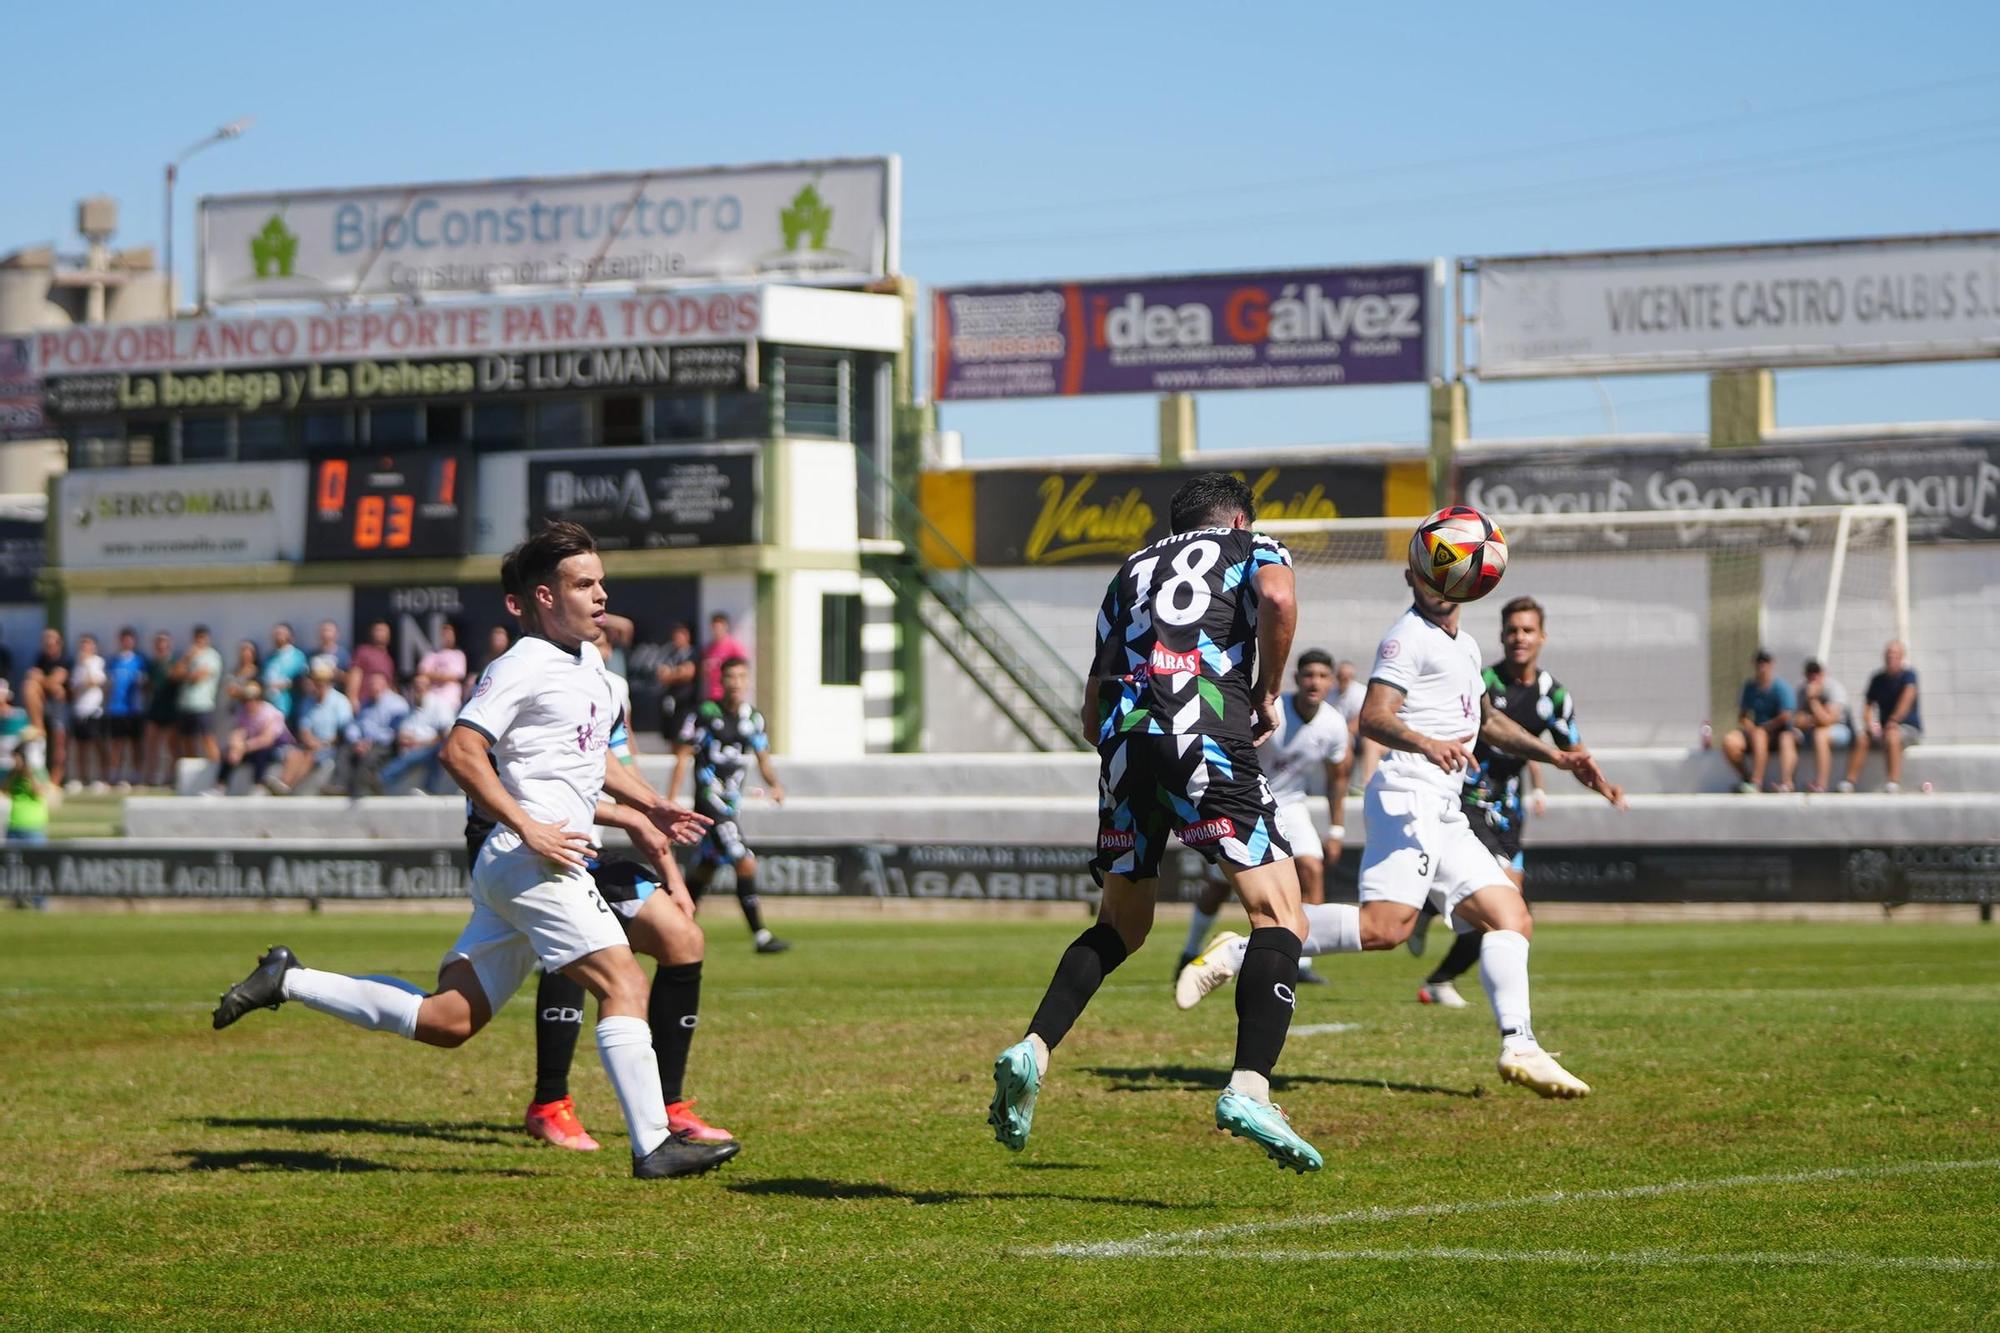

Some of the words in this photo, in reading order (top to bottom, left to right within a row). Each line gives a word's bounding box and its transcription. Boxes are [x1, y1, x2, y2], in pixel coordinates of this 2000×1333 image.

[336, 192, 743, 254] BioConstructora
[40, 314, 297, 368] POZOBLANCO
[505, 301, 607, 343] PARA
[621, 293, 760, 338] TOD@S
[1093, 293, 1213, 350] idea
[1226, 283, 1421, 343] Gálvez
[1605, 281, 1723, 335] VICENTE
[1731, 276, 1845, 328] CASTRO
[1853, 272, 1958, 324] GALBIS
[119, 373, 156, 408] La
[162, 371, 282, 411] bodega
[286, 373, 305, 408] y
[310, 363, 350, 397] La
[355, 359, 476, 394] Dehesa
[478, 356, 525, 391] DE
[98, 487, 275, 519] SERCOMALLA
[318, 459, 348, 512] 0
[440, 457, 457, 506] 1
[391, 585, 463, 612] HOTEL
[1125, 539, 1221, 641] 18
[58, 855, 171, 895] AMSTEL
[267, 855, 389, 896] AMSTEL
[711, 855, 840, 894] ASTEL
[1418, 852, 1429, 877] 3
